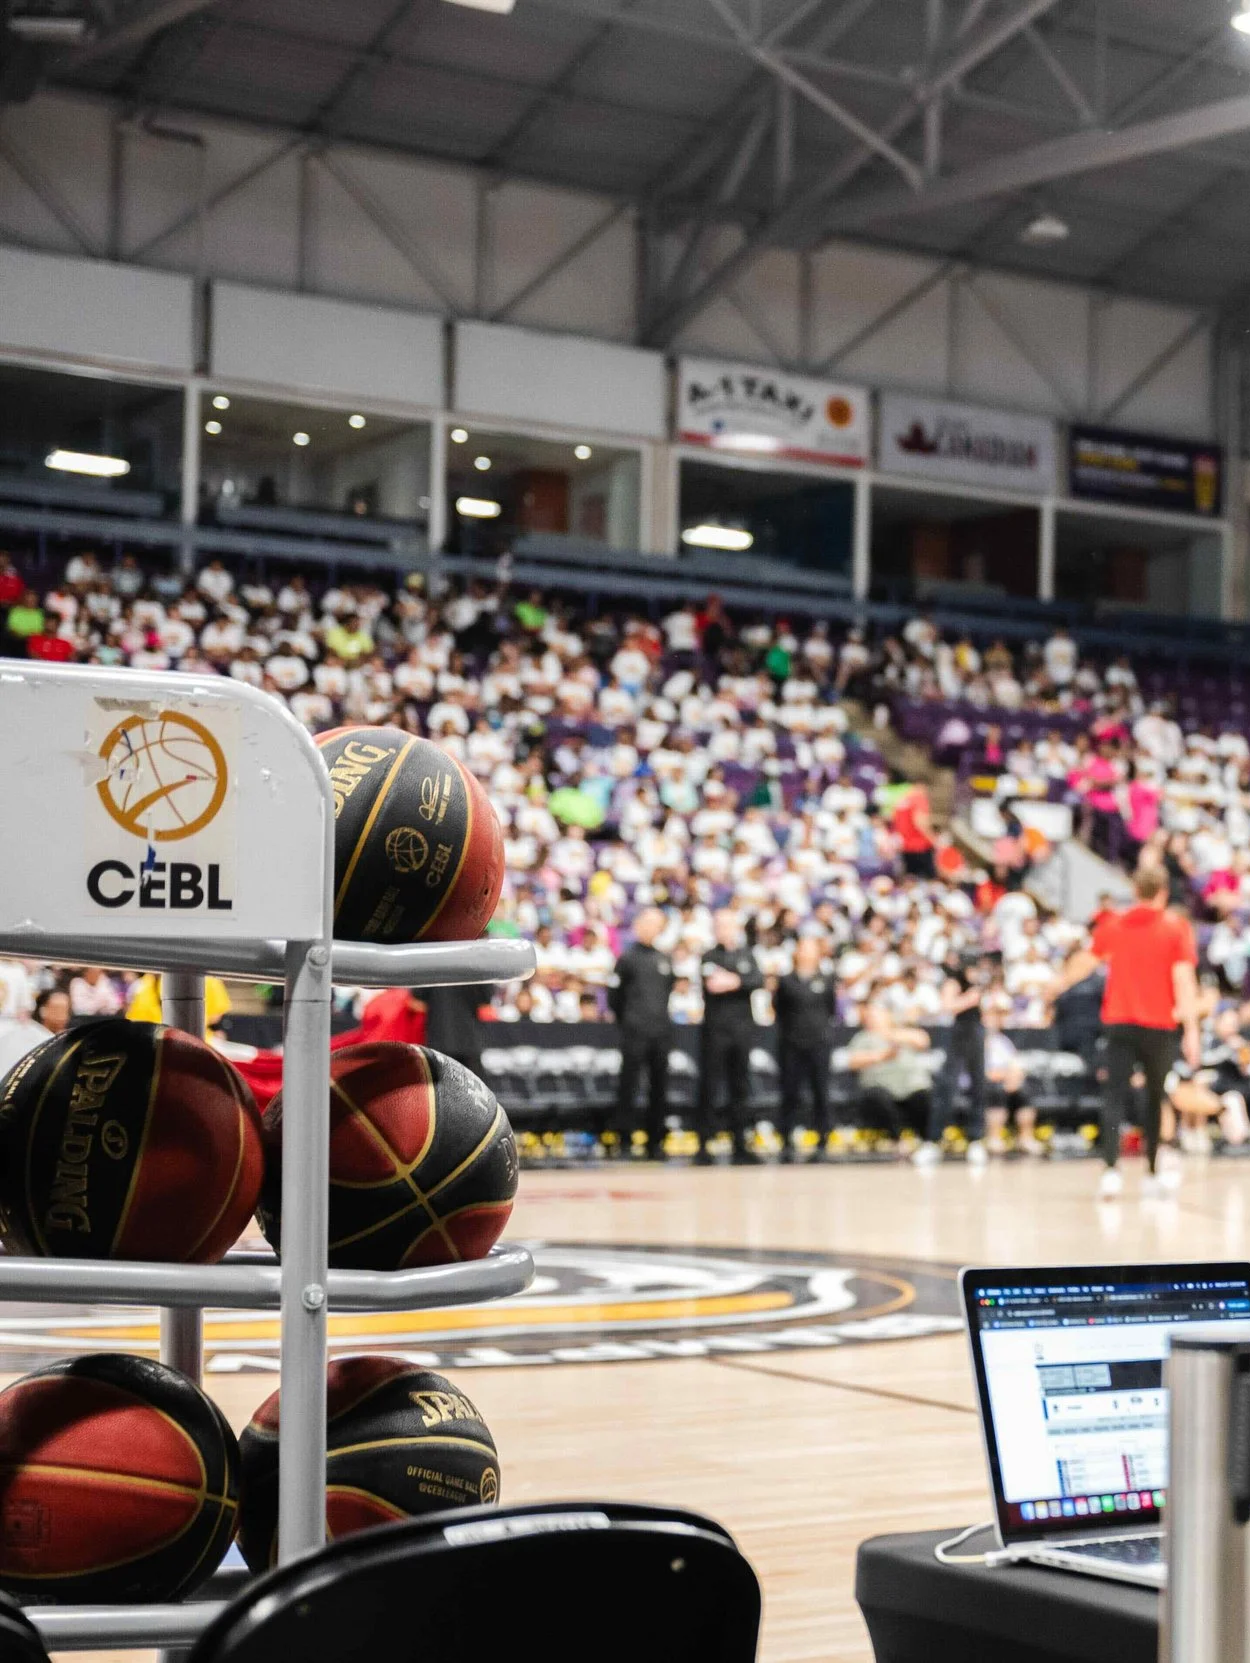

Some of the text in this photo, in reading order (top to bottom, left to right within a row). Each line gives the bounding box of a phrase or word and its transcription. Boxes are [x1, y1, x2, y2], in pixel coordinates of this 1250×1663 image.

[87, 859, 233, 911] CEBL
[407, 1465, 480, 1495] OFFICIAL GAME BALL
